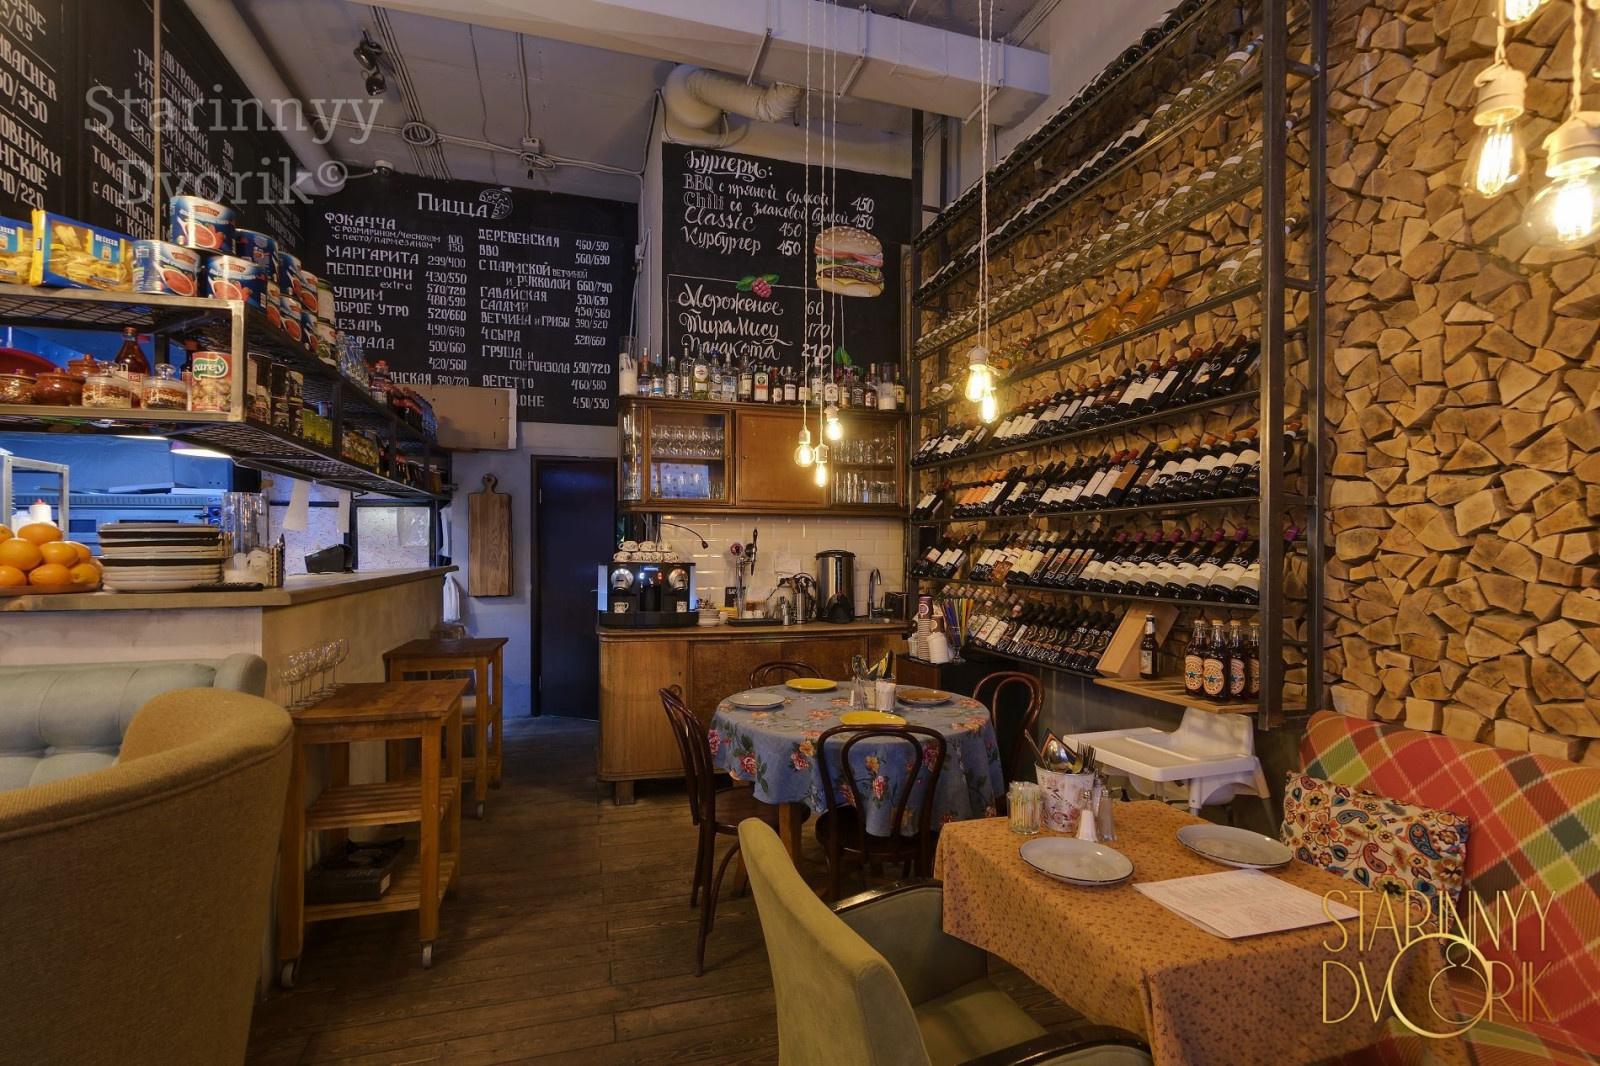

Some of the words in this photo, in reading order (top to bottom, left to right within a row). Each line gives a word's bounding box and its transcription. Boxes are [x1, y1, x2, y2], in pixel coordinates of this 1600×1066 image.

[0, 33, 57, 102] BACHER
[161, 50, 204, 107] АВТРАКИ
[0, 68, 47, 124] 0/350
[92, 145, 137, 196] ТОМАТЫ
[683, 173, 714, 194] BBQ
[851, 197, 874, 215] 450
[683, 191, 724, 211] Chili
[730, 200, 743, 212] со
[851, 214, 874, 231] 450
[324, 212, 397, 231] ФОКАЧЧА
[684, 206, 756, 232] Classic
[779, 222, 802, 239] 450
[478, 228, 560, 248] ДЕРЕВЕНСКАЯ
[681, 225, 762, 257] Курбургер
[777, 241, 801, 257] 450
[326, 244, 419, 265] МАРГАРИТА
[427, 255, 466, 269] 299/400
[326, 262, 413, 281] ПЕППЕРОНИ
[425, 271, 467, 285] 430/550
[490, 260, 551, 276] ПАРМСКОЙ
[380, 280, 413, 291] extra
[426, 283, 466, 296] 570/720
[480, 286, 548, 302] ГАВАЙСКАЯ
[577, 280, 613, 294] 660/790
[480, 298, 529, 313] САЛЯМИ
[678, 283, 784, 316] Мороженое
[378, 304, 409, 317] УТРО
[427, 307, 467, 322] 520/660
[481, 311, 532, 326] ВЕТЧИНА
[541, 315, 571, 328] ГРИБЫ
[335, 318, 382, 333] ЕЗАРЬ
[427, 323, 466, 338] 490/640
[428, 340, 466, 354] 500/660
[481, 344, 522, 359] ГРУША
[428, 357, 467, 371] 420/560
[509, 359, 570, 374] ГОРГОНЗОЛА
[482, 374, 534, 389] ВЕГЕТТО
[516, 394, 545, 408] ОНЕ
